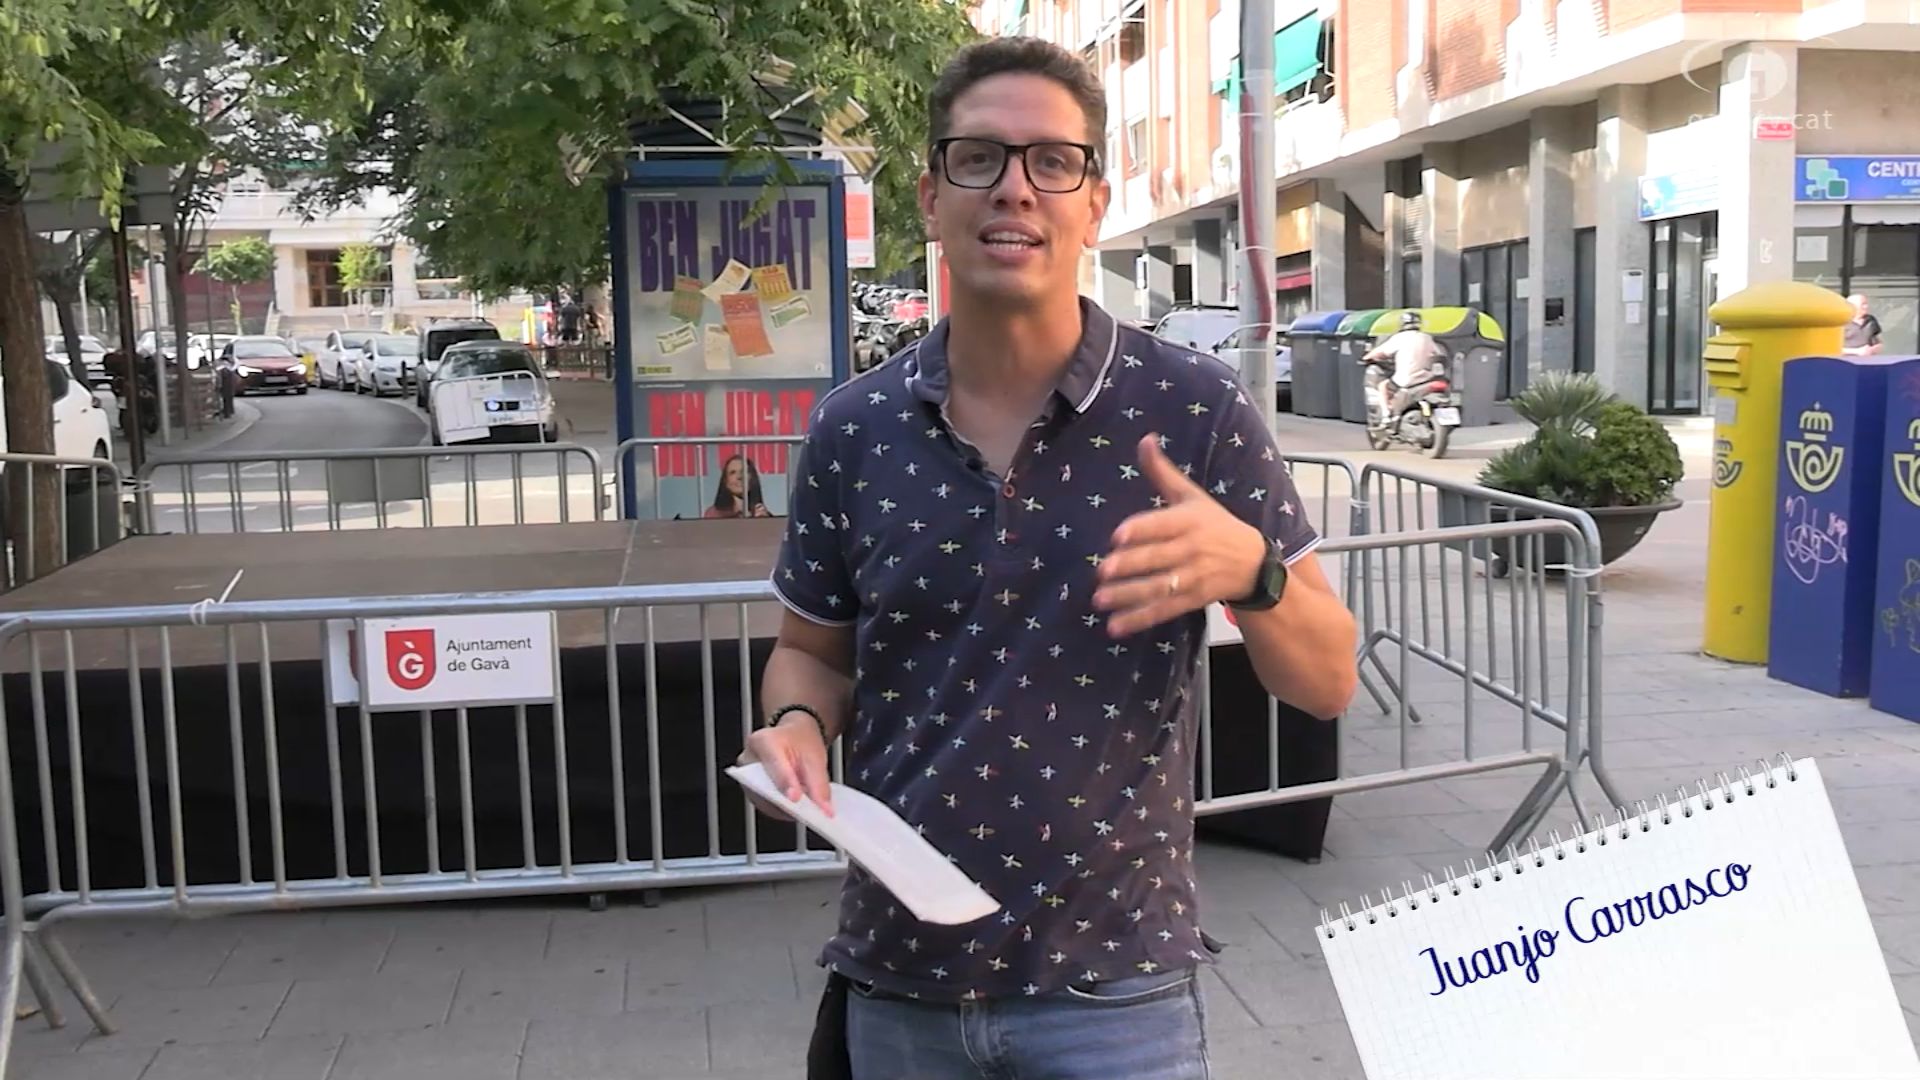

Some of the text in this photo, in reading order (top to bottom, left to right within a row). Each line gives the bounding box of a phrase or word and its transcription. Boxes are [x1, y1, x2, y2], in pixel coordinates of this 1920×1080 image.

[637, 200, 815, 293] BEN JUGAT
[650, 392, 707, 477] BEN
[446, 637, 533, 654] Ajuntament
[447, 656, 510, 672] de Gavà
